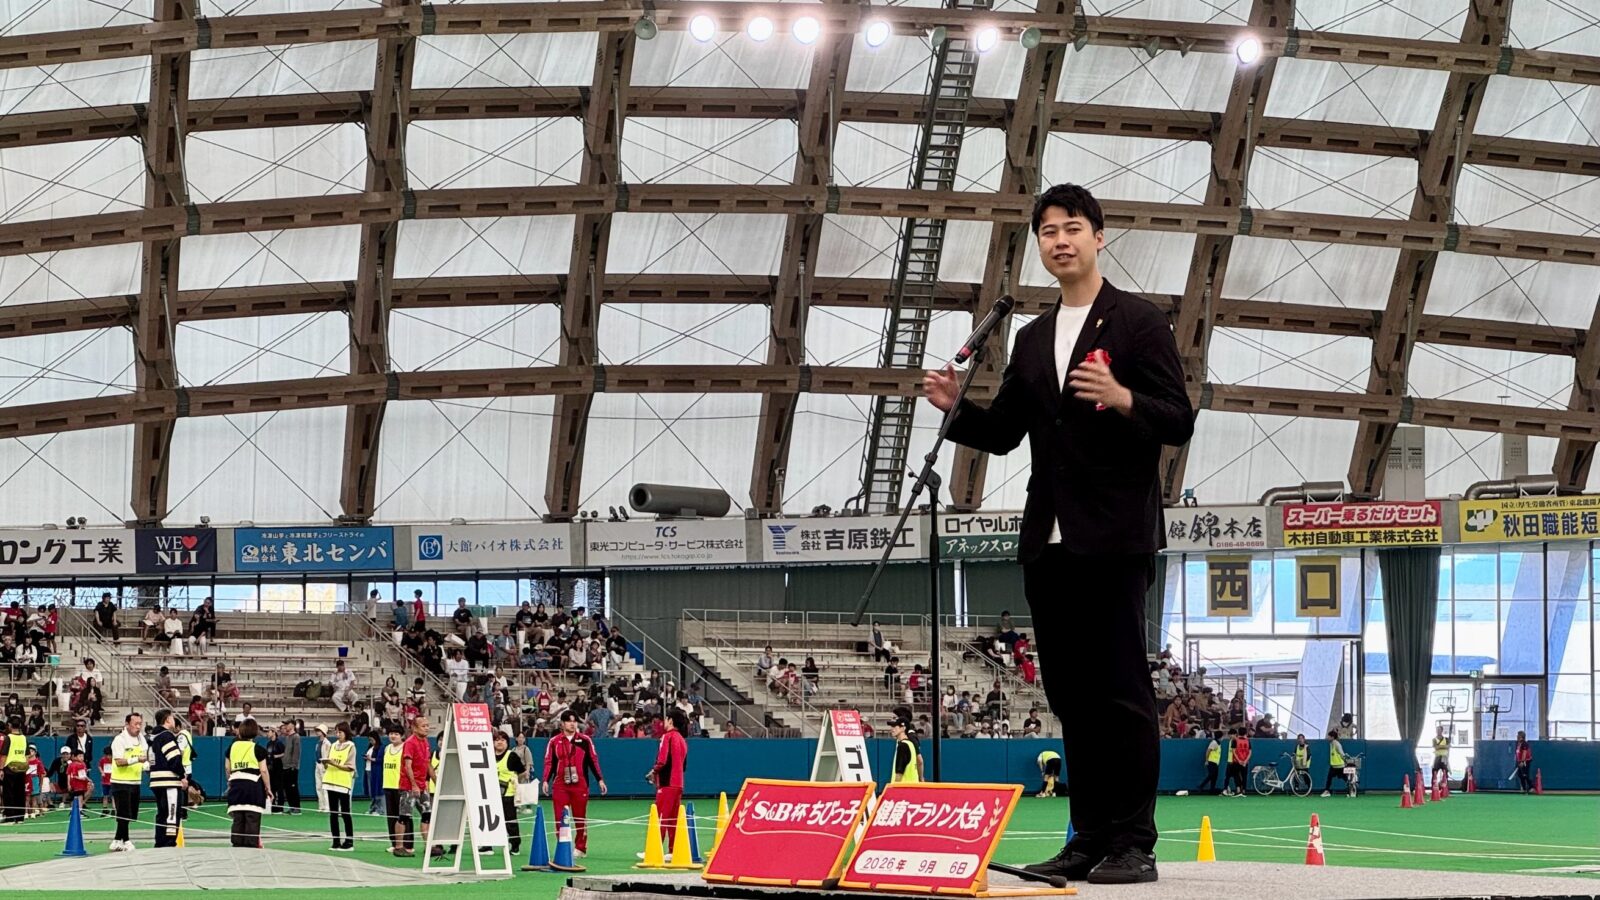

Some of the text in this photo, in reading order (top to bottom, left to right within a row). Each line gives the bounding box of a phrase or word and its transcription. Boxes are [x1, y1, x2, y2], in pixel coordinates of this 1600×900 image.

[1287, 505, 1437, 525] スーパー乗るだけセット
[655, 526, 677, 538] TCS
[1503, 511, 1599, 538] 秋田職能短
[155, 536, 183, 550] WE
[801, 529, 821, 540] 株式
[824, 528, 915, 550] 吉原鉄工
[1288, 529, 1439, 545] 木村自動車工業株式会社
[281, 541, 387, 565] 東北センバ
[447, 538, 564, 553] 大館バイオ株式会社
[590, 539, 744, 552] 東光コンピュータ・サービス株式会社
[801, 540, 821, 551] 会社
[155, 551, 199, 566] NLI
[1209, 562, 1249, 610] 西
[467, 741, 500, 832] ゴール
[872, 799, 986, 830] 健康マラソン大会
[863, 857, 968, 875] 2026年 9月 6日
